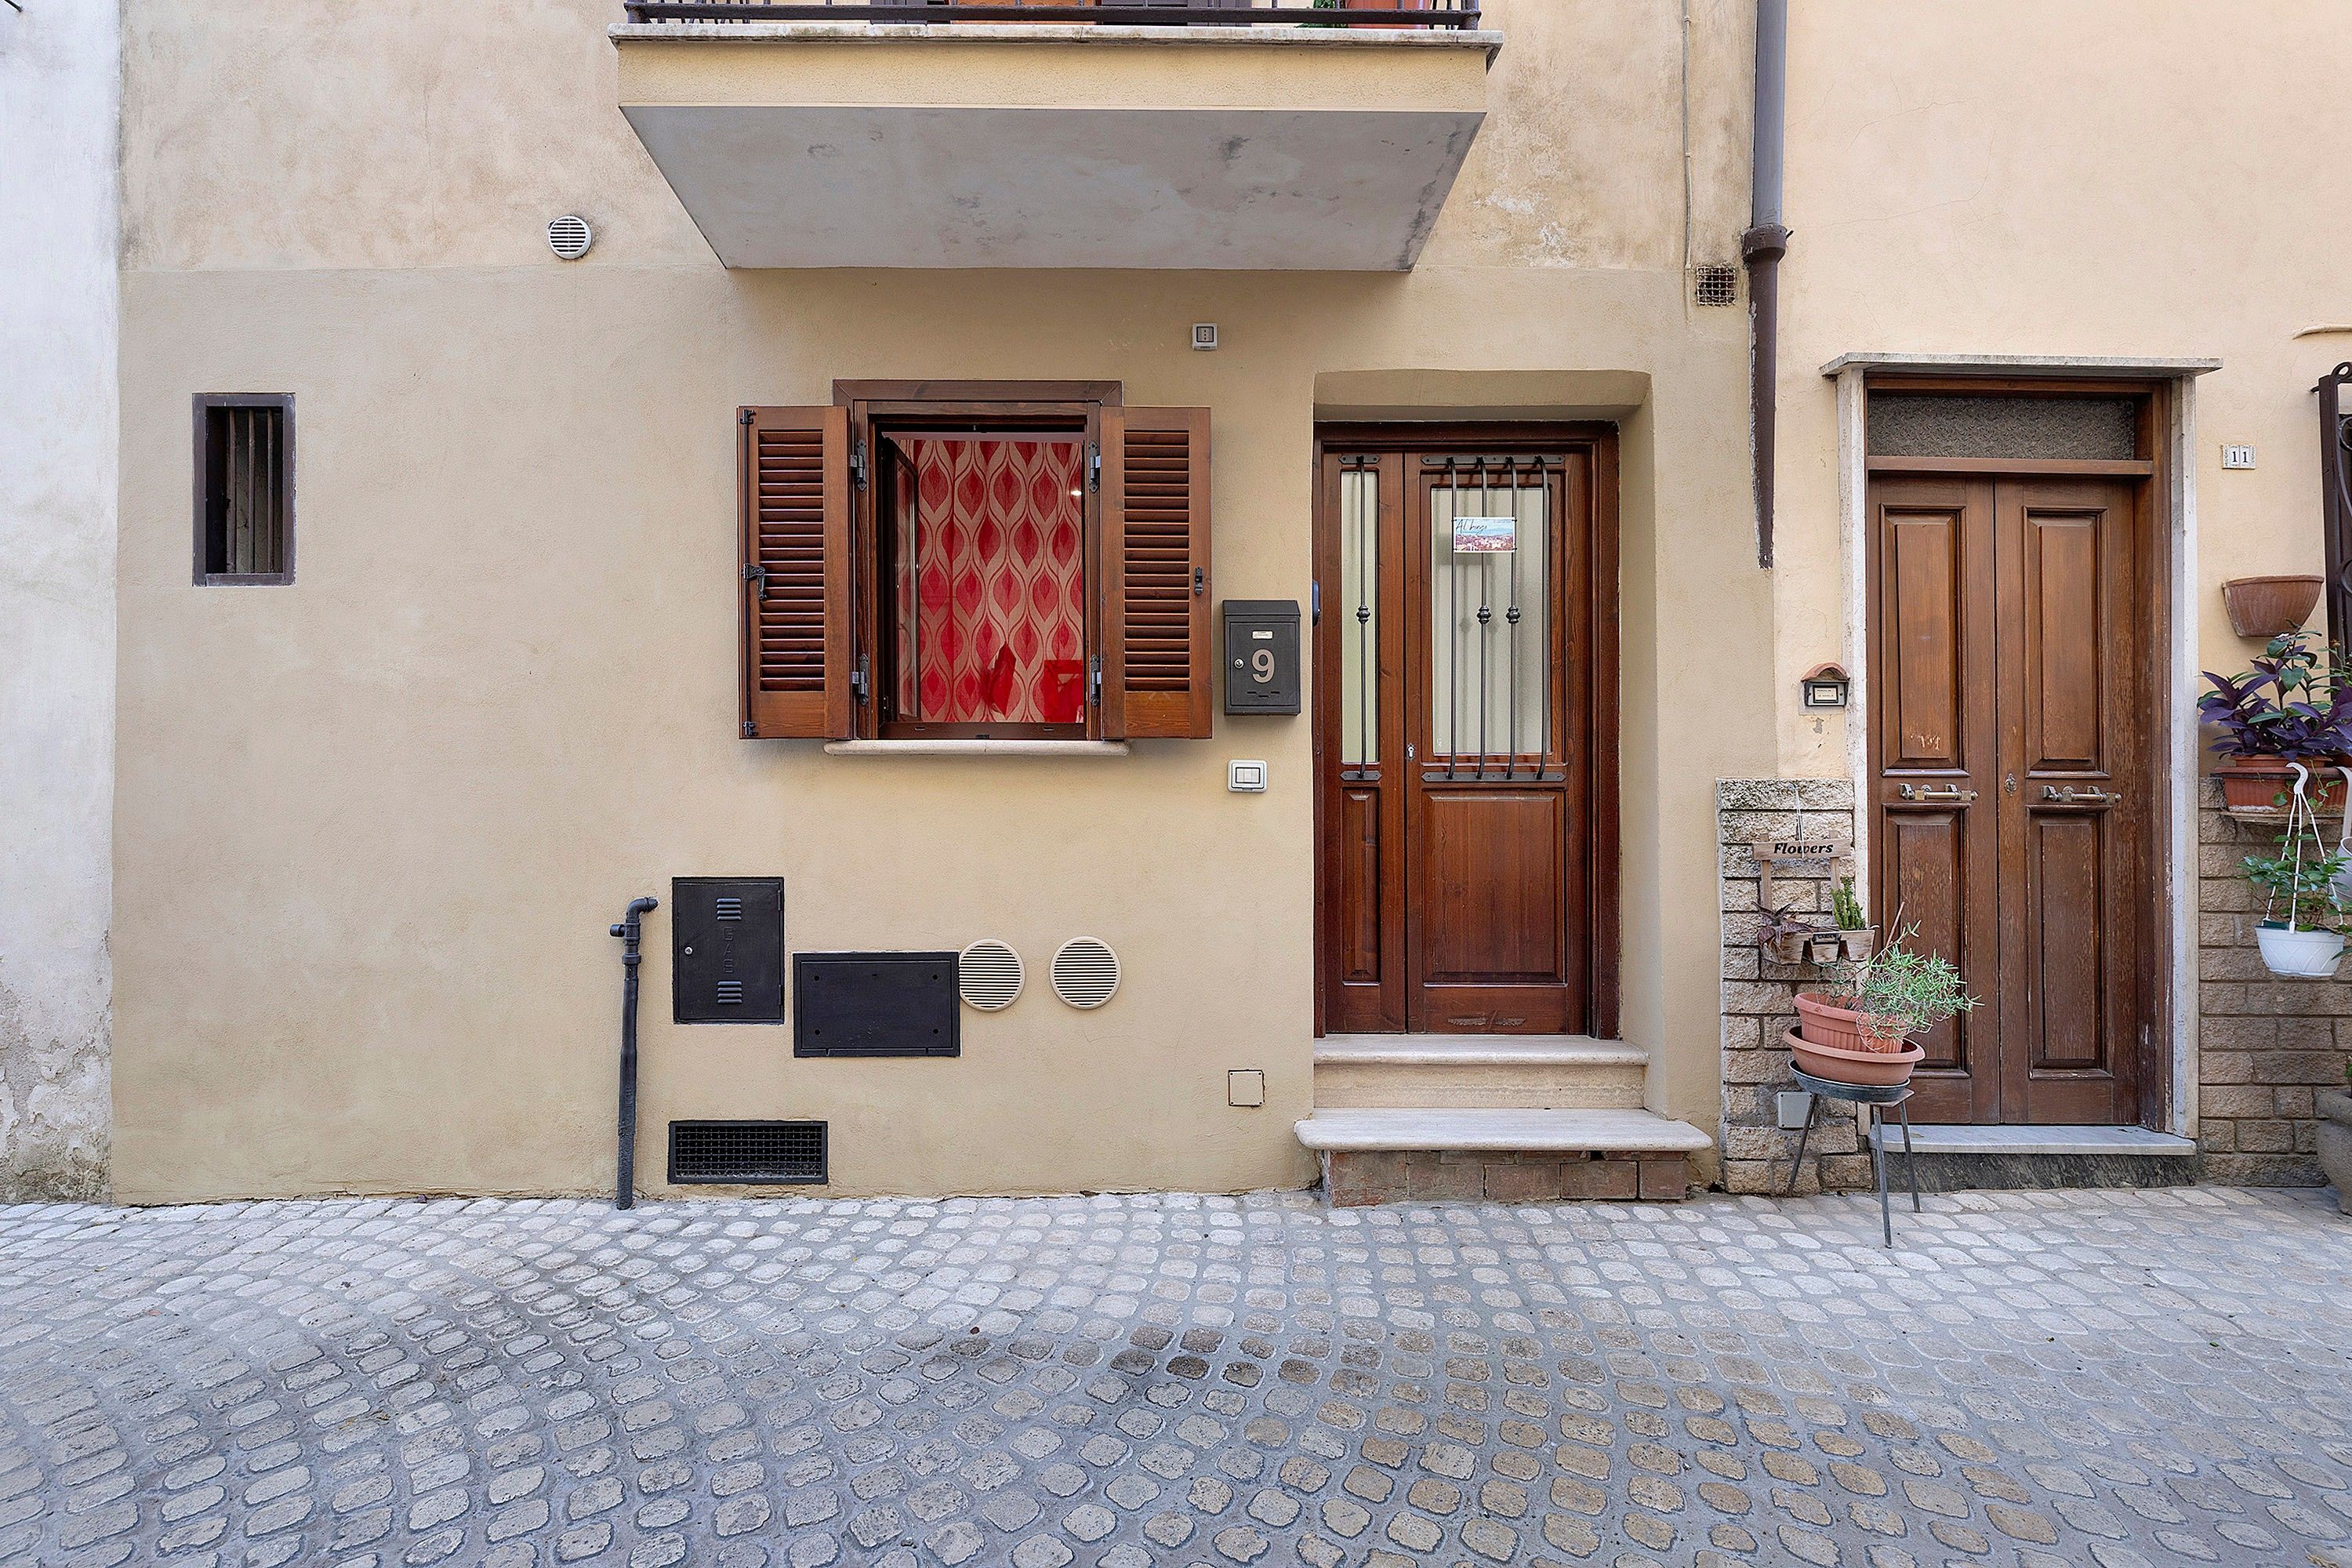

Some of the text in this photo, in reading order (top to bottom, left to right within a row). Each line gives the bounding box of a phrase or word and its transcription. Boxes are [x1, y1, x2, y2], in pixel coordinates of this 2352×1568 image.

[2232, 451, 2249, 463] 11
[1252, 648, 1275, 684] 9
[1773, 842, 1834, 855] Flowers
[722, 926, 735, 974] GAS
